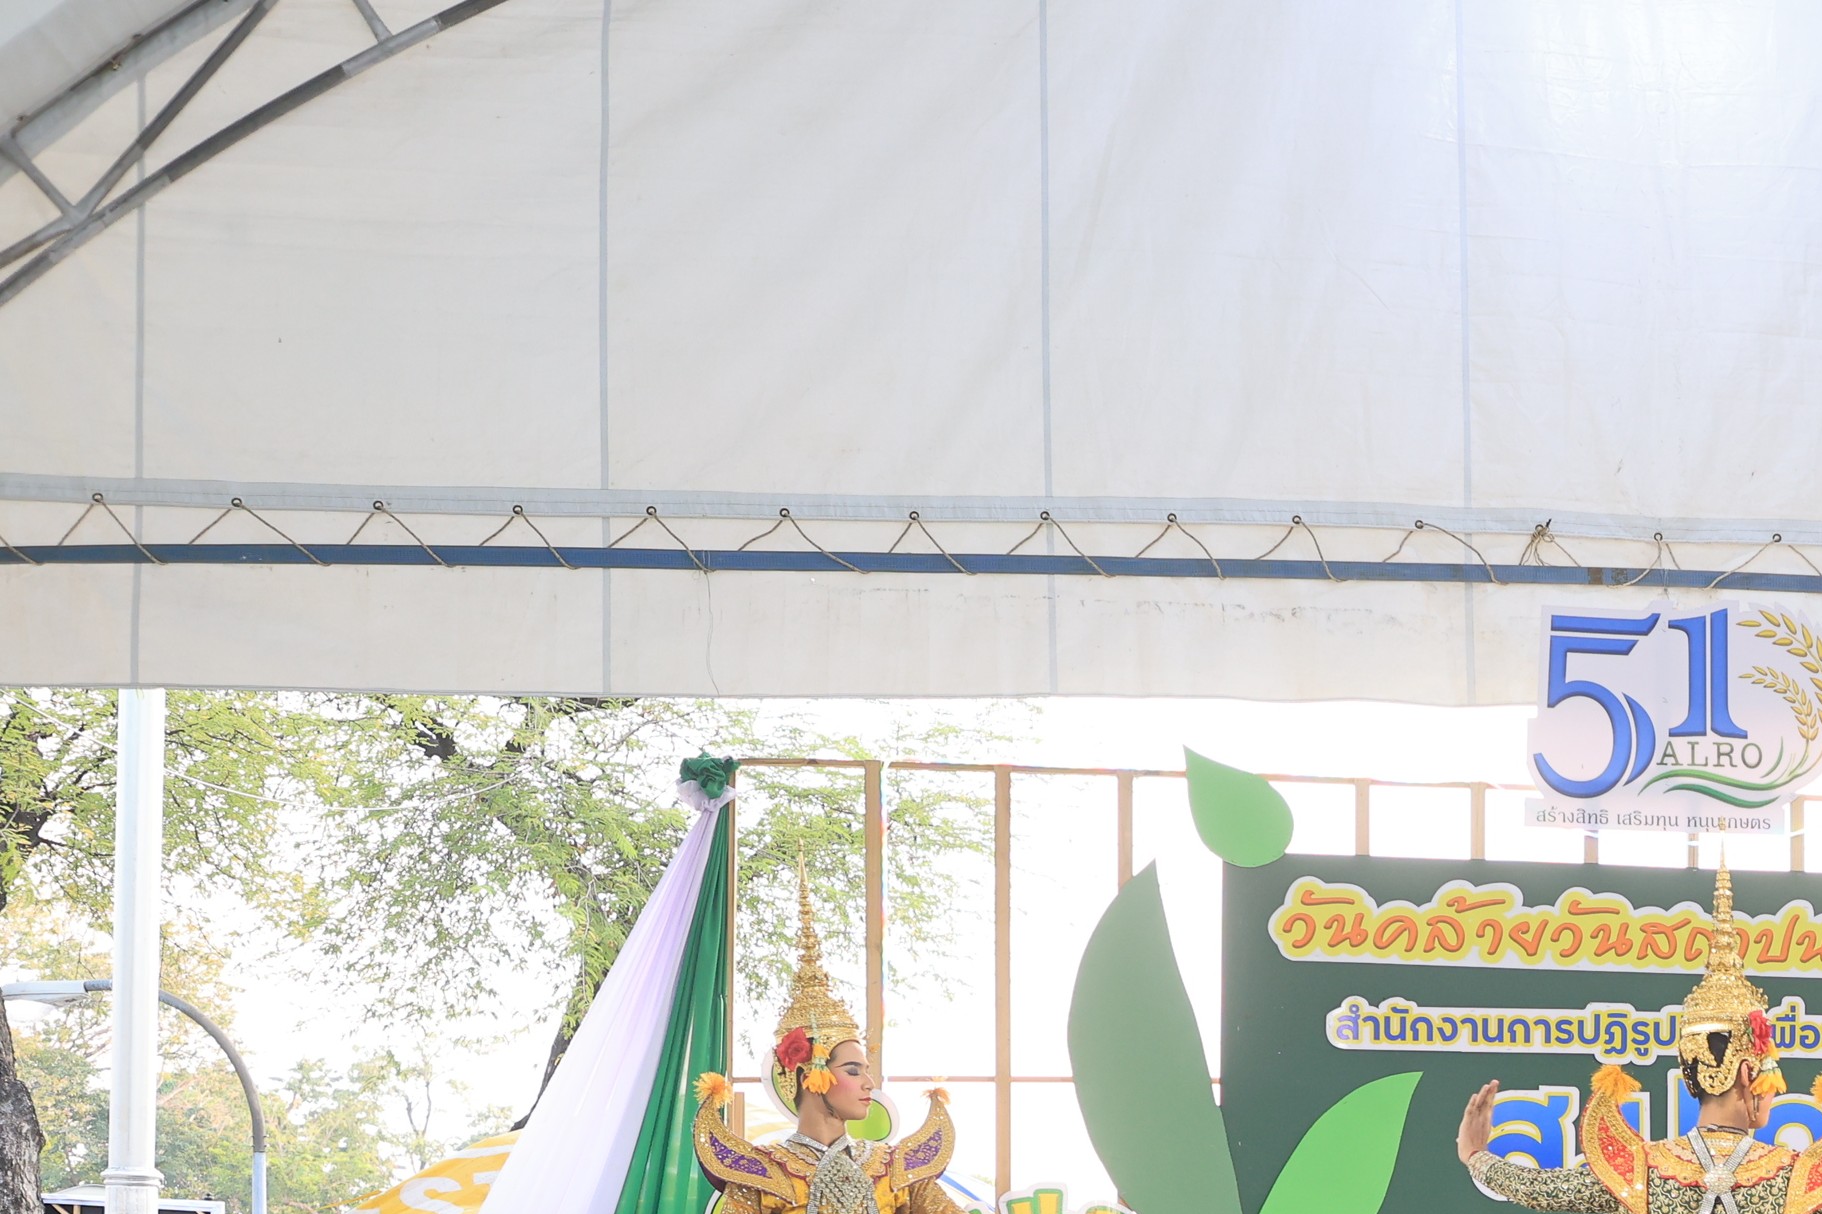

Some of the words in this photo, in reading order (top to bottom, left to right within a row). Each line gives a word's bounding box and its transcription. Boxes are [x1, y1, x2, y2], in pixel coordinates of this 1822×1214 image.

[1533, 608, 1748, 799] 51
[1656, 740, 1763, 769] ALRO
[1536, 805, 1610, 826] สร้างสิทธิ
[1617, 811, 1680, 832] เสริมทุน
[1687, 813, 1771, 833] หนุนกษตร
